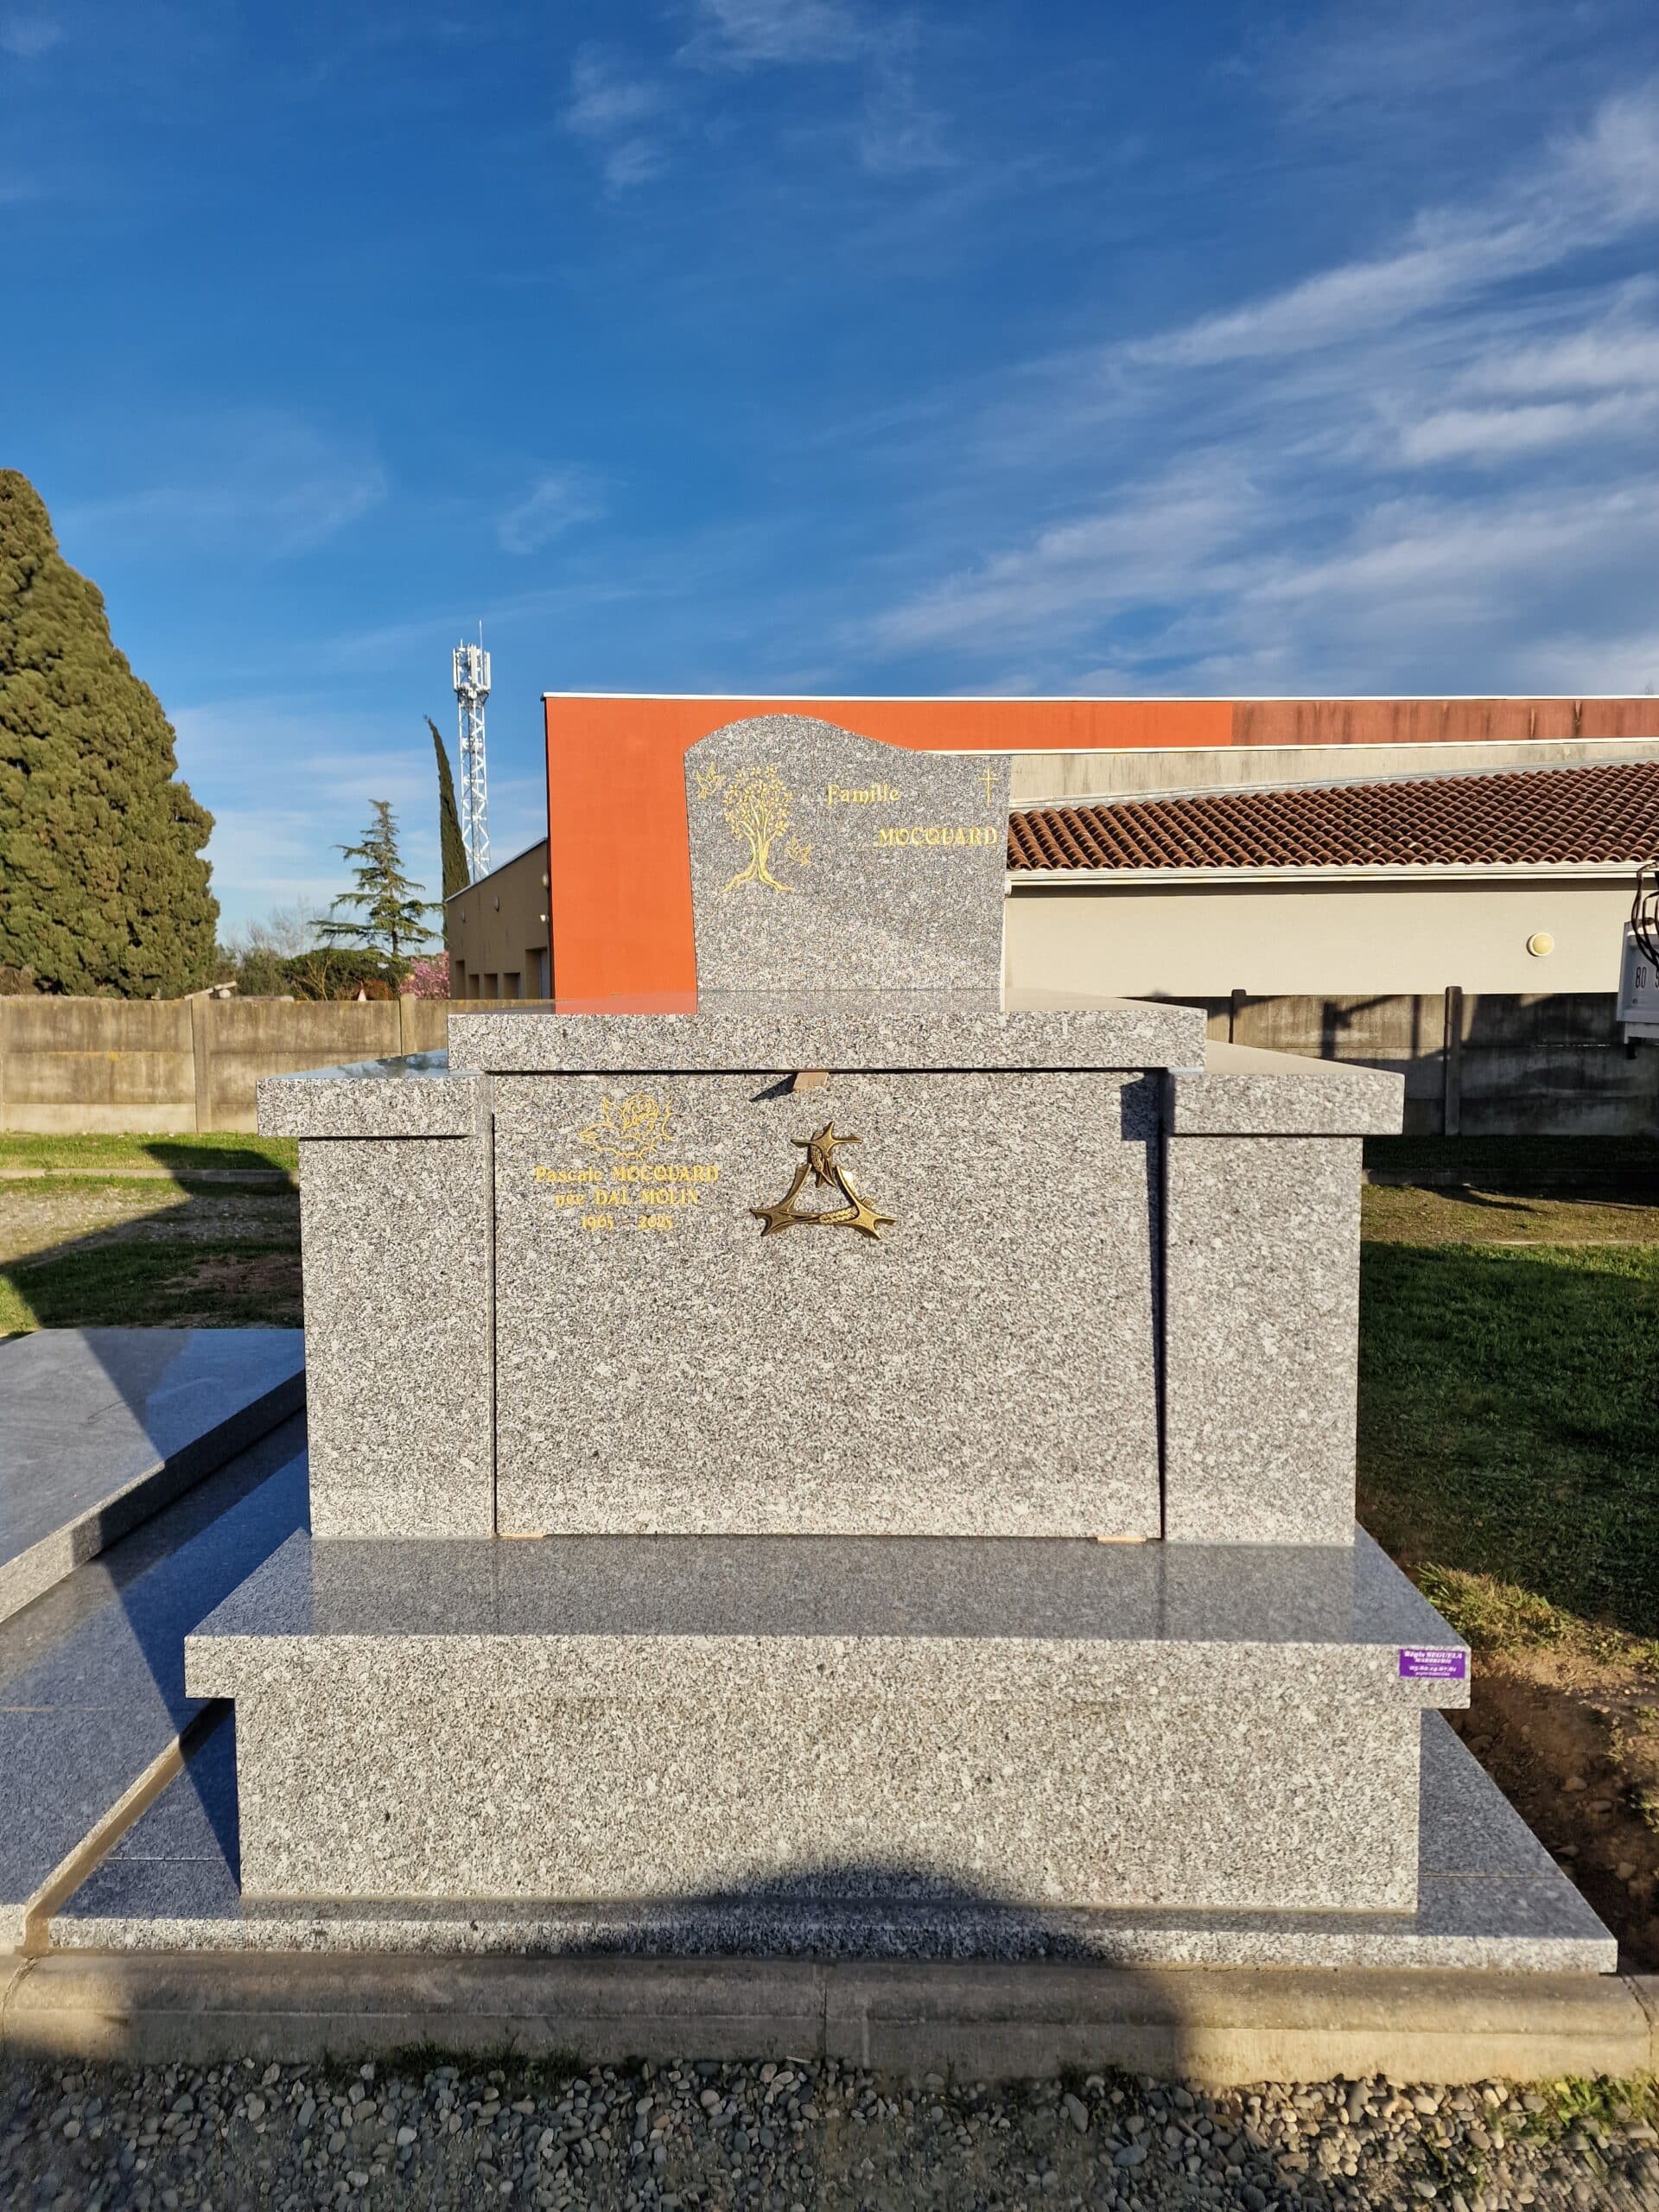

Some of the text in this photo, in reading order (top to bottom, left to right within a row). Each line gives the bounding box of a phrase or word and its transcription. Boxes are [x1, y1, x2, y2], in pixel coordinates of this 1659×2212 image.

[827, 783, 899, 806] Famille
[878, 827, 998, 846] MOCQUARD
[1635, 966, 1647, 988] 80
[535, 1166, 719, 1183] Pascale MOCQUARD
[555, 1189, 585, 1208] née
[641, 1189, 699, 1205] MOLIN
[582, 1213, 614, 1232] 1965
[638, 1214, 673, 1230] 2025
